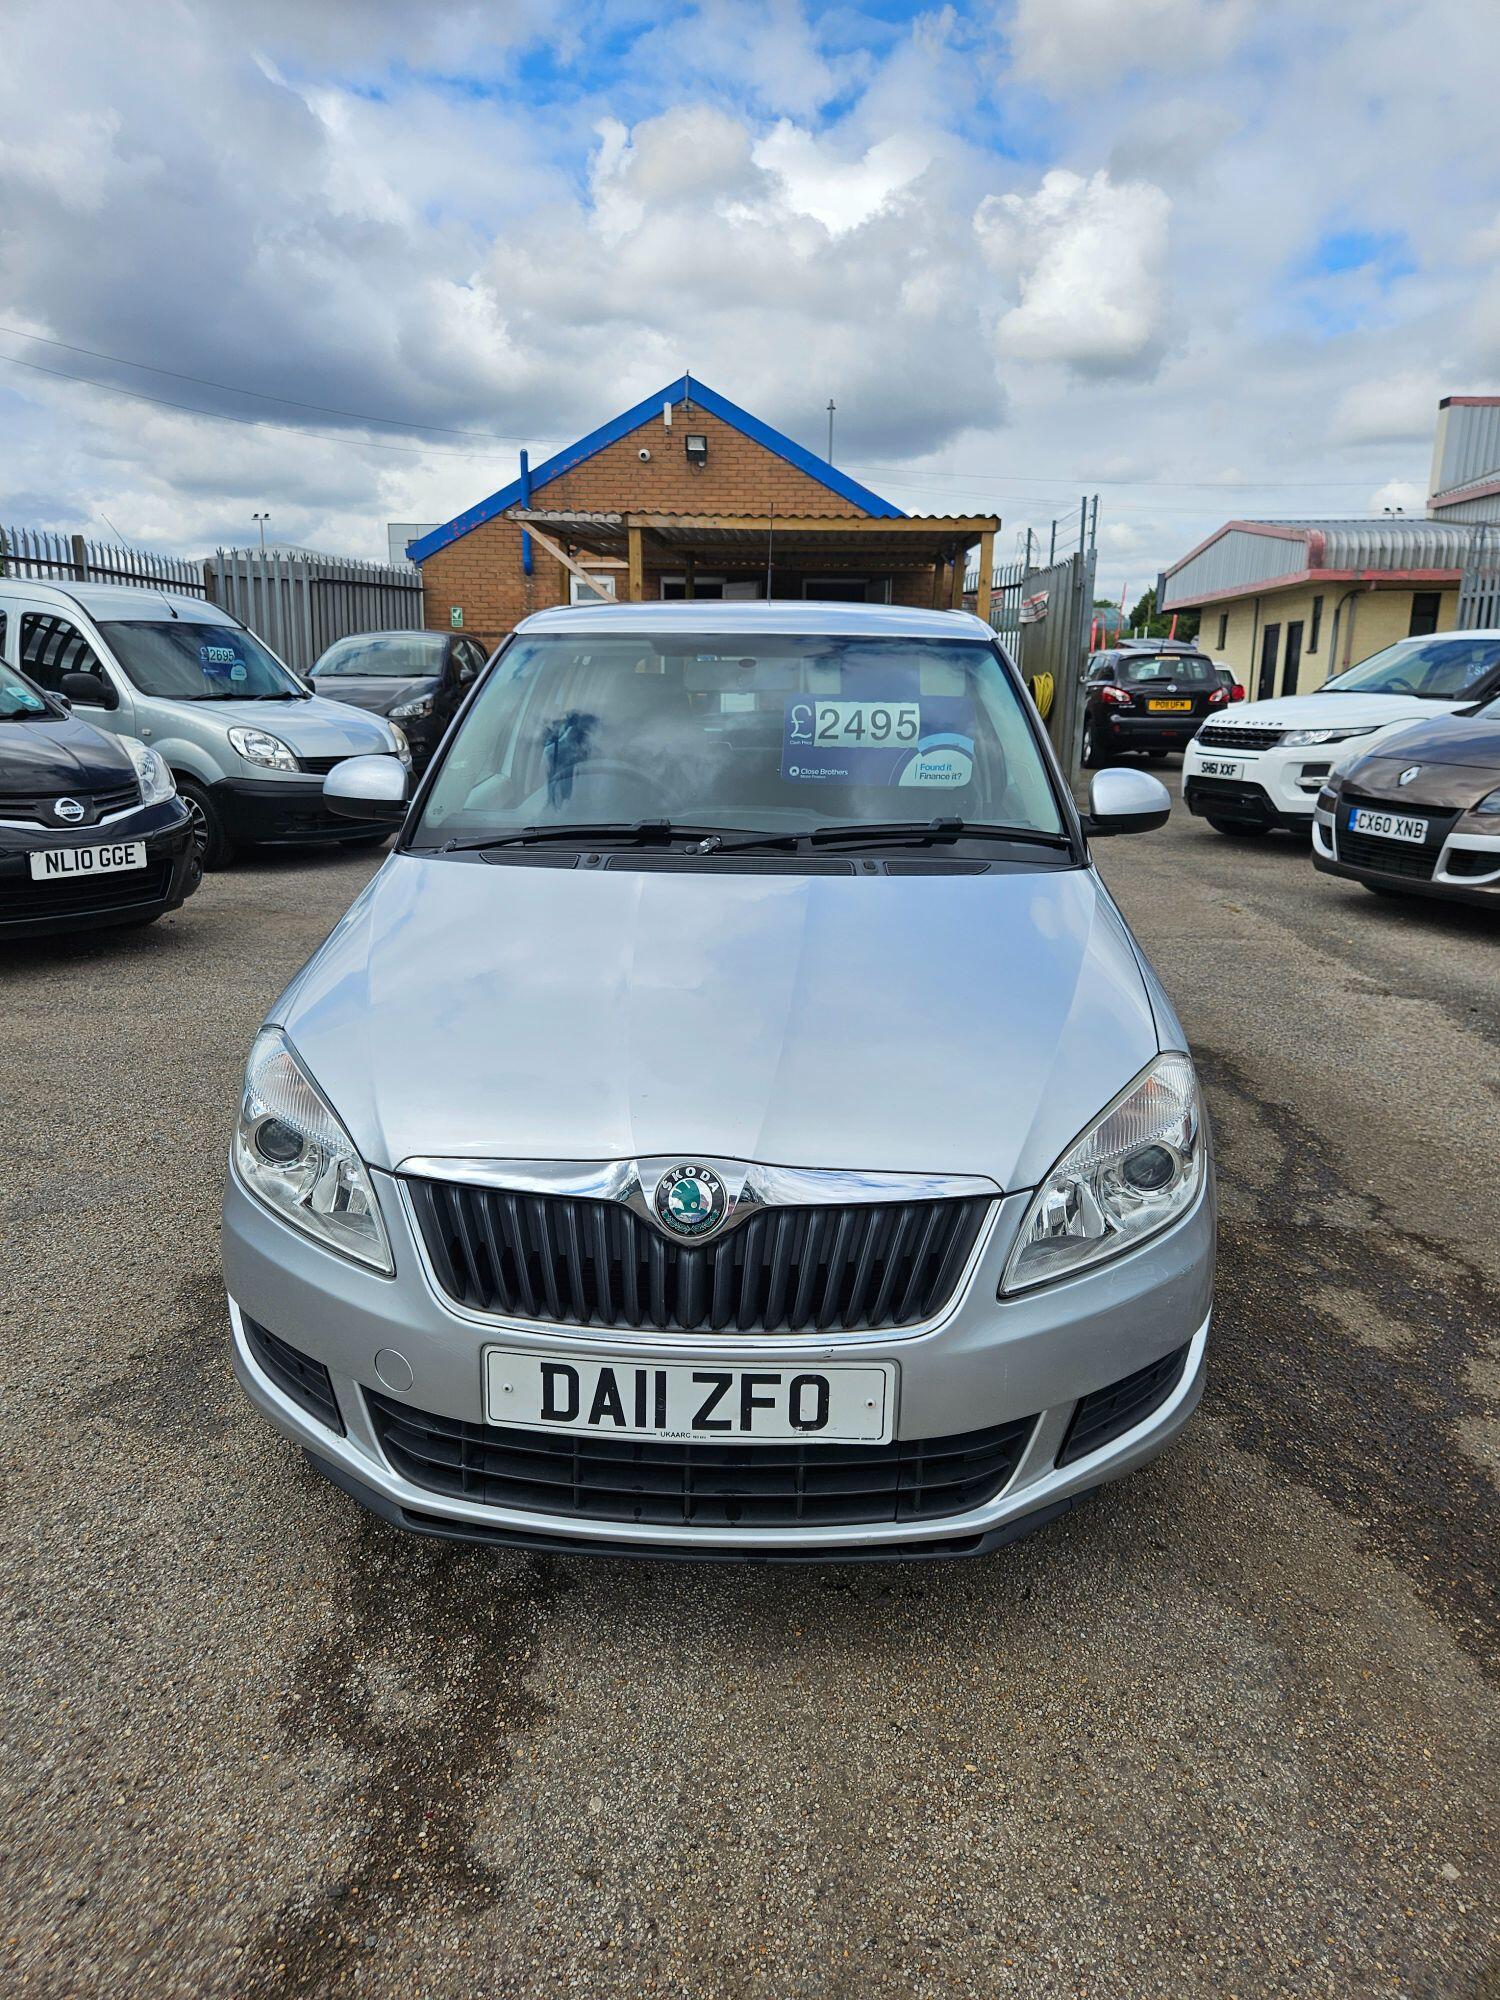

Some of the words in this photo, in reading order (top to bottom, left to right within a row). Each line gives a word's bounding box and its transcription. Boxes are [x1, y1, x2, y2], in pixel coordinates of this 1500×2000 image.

[790, 704, 917, 741] £2495
[820, 768, 848, 776] Brothers
[1201, 762, 1218, 774] SH61
[1220, 764, 1237, 776] XXF
[1358, 813, 1391, 833] CX60
[1394, 819, 1424, 839] XNB
[45, 850, 93, 874] NL10
[99, 845, 136, 868] GGE
[540, 1362, 667, 1429] DA11
[691, 1372, 830, 1431] ZFO
